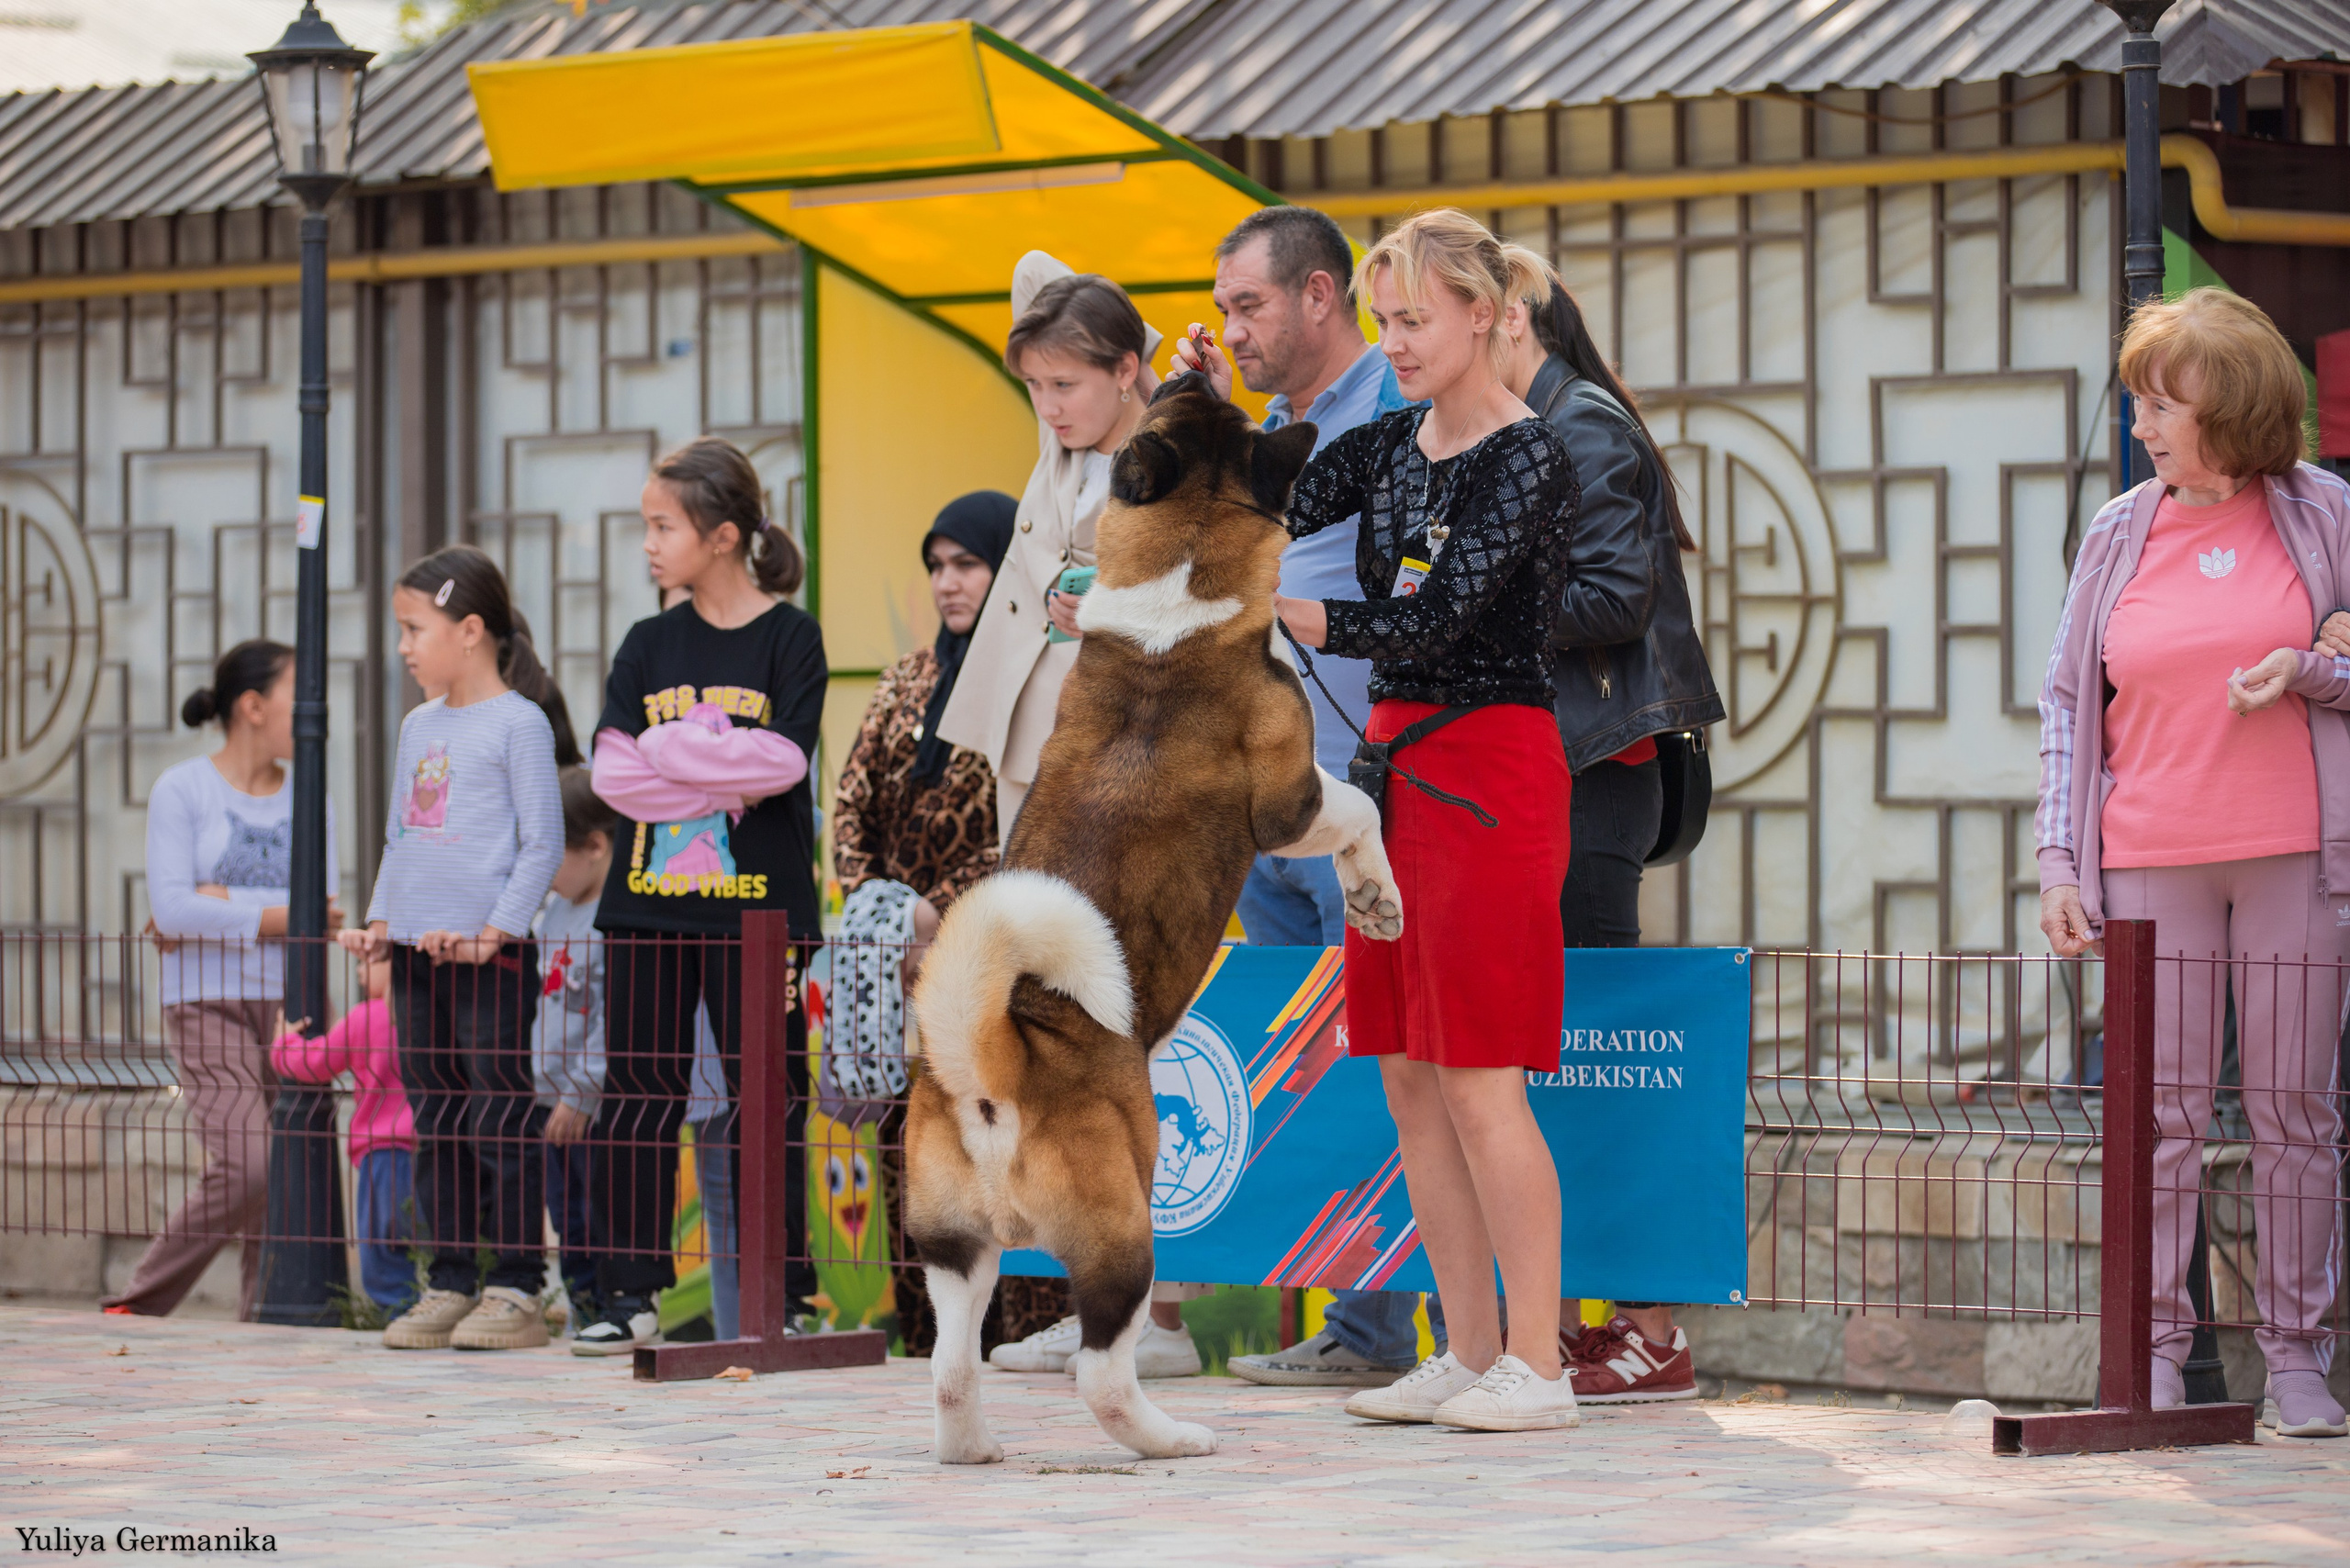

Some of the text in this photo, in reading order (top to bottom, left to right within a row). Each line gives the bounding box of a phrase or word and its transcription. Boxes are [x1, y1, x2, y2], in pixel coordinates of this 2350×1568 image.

[628, 870, 768, 900] GOOD VIBES
[1560, 1029, 1685, 1053] DERATION
[1528, 1065, 1684, 1090] UZBEKISTAN
